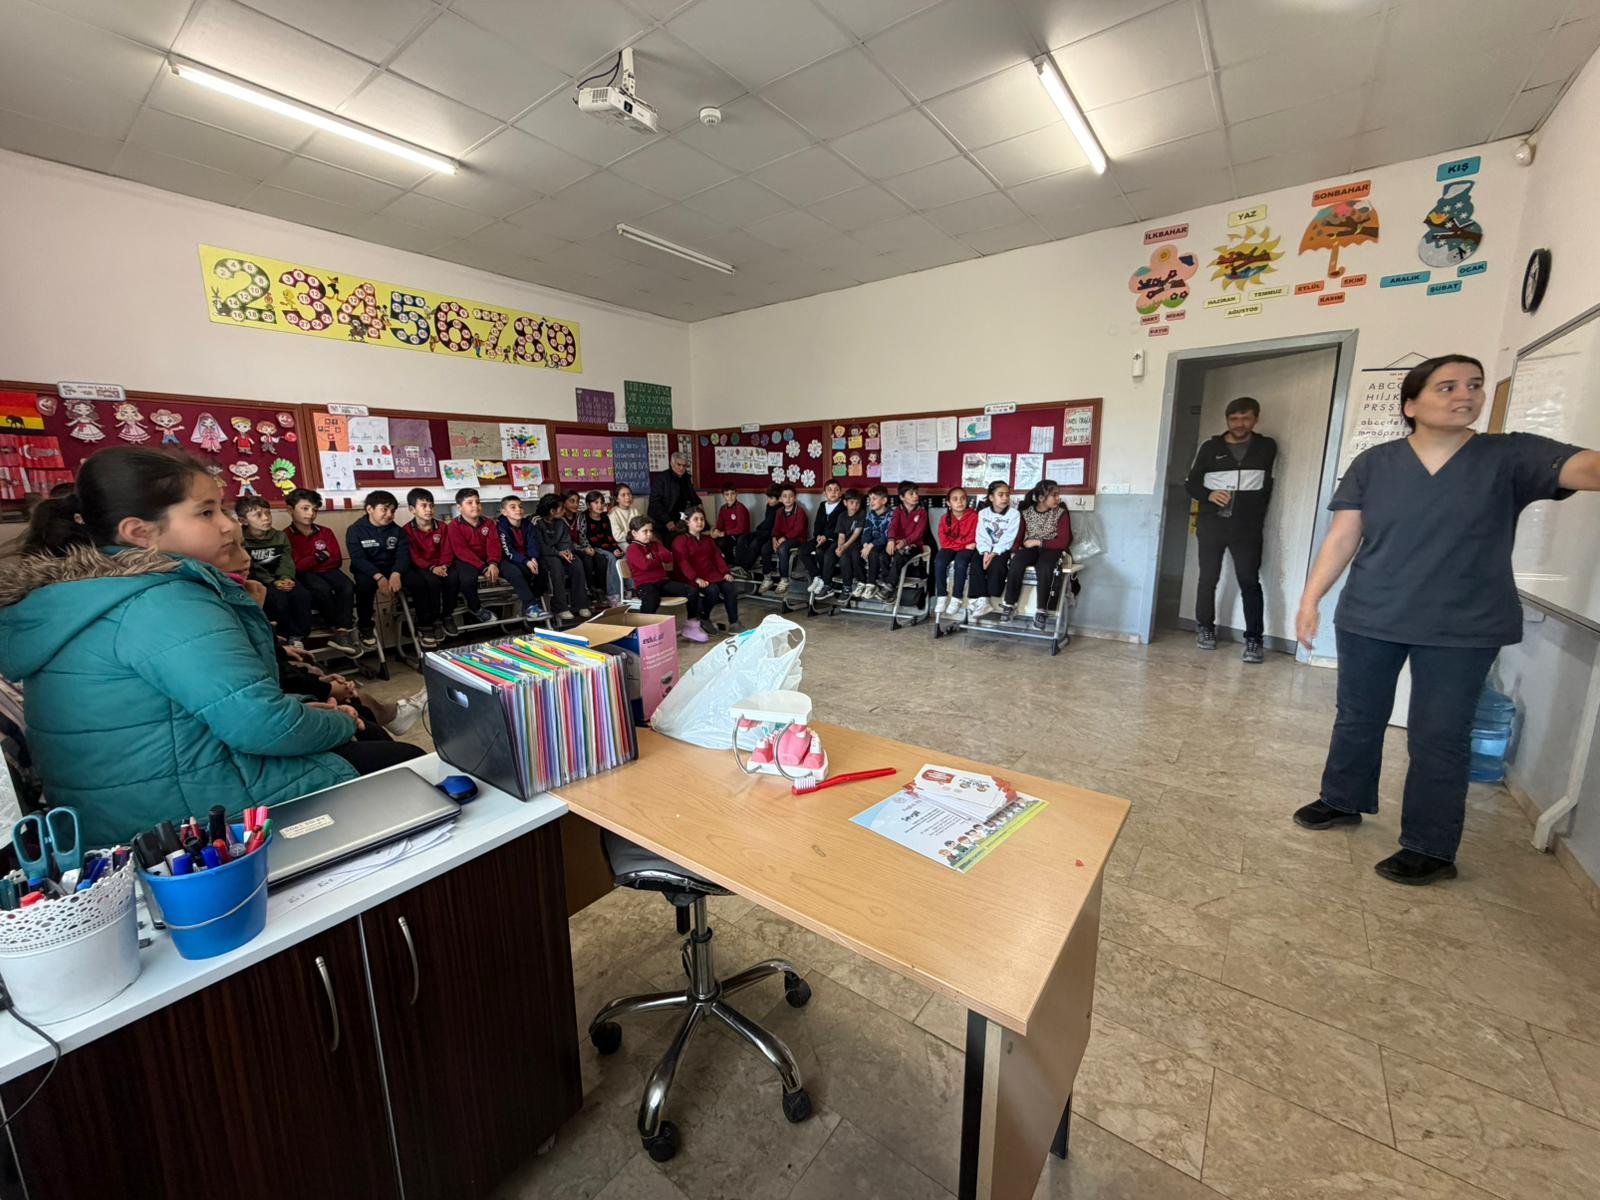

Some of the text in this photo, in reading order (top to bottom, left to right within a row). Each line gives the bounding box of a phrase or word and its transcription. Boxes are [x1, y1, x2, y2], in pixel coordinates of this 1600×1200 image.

[1448, 163, 1469, 174] KIŞ
[1314, 184, 1369, 200] SONBAHAR
[1237, 210, 1257, 221] YAZ
[1145, 226, 1188, 240] İLKBAHAR
[1459, 263, 1484, 273] OCAK
[1390, 274, 1420, 284] ARALIK
[1254, 288, 1282, 298] TEMMUZ
[1430, 284, 1459, 293] ŞUBAT
[1320, 294, 1344, 302] KASIM
[279, 268, 334, 331] 3
[337, 283, 386, 339] 4
[390, 291, 431, 346] 5
[435, 302, 473, 352] 6
[472, 308, 509, 358] 7
[514, 316, 546, 362] 8
[547, 322, 576, 367] 9
